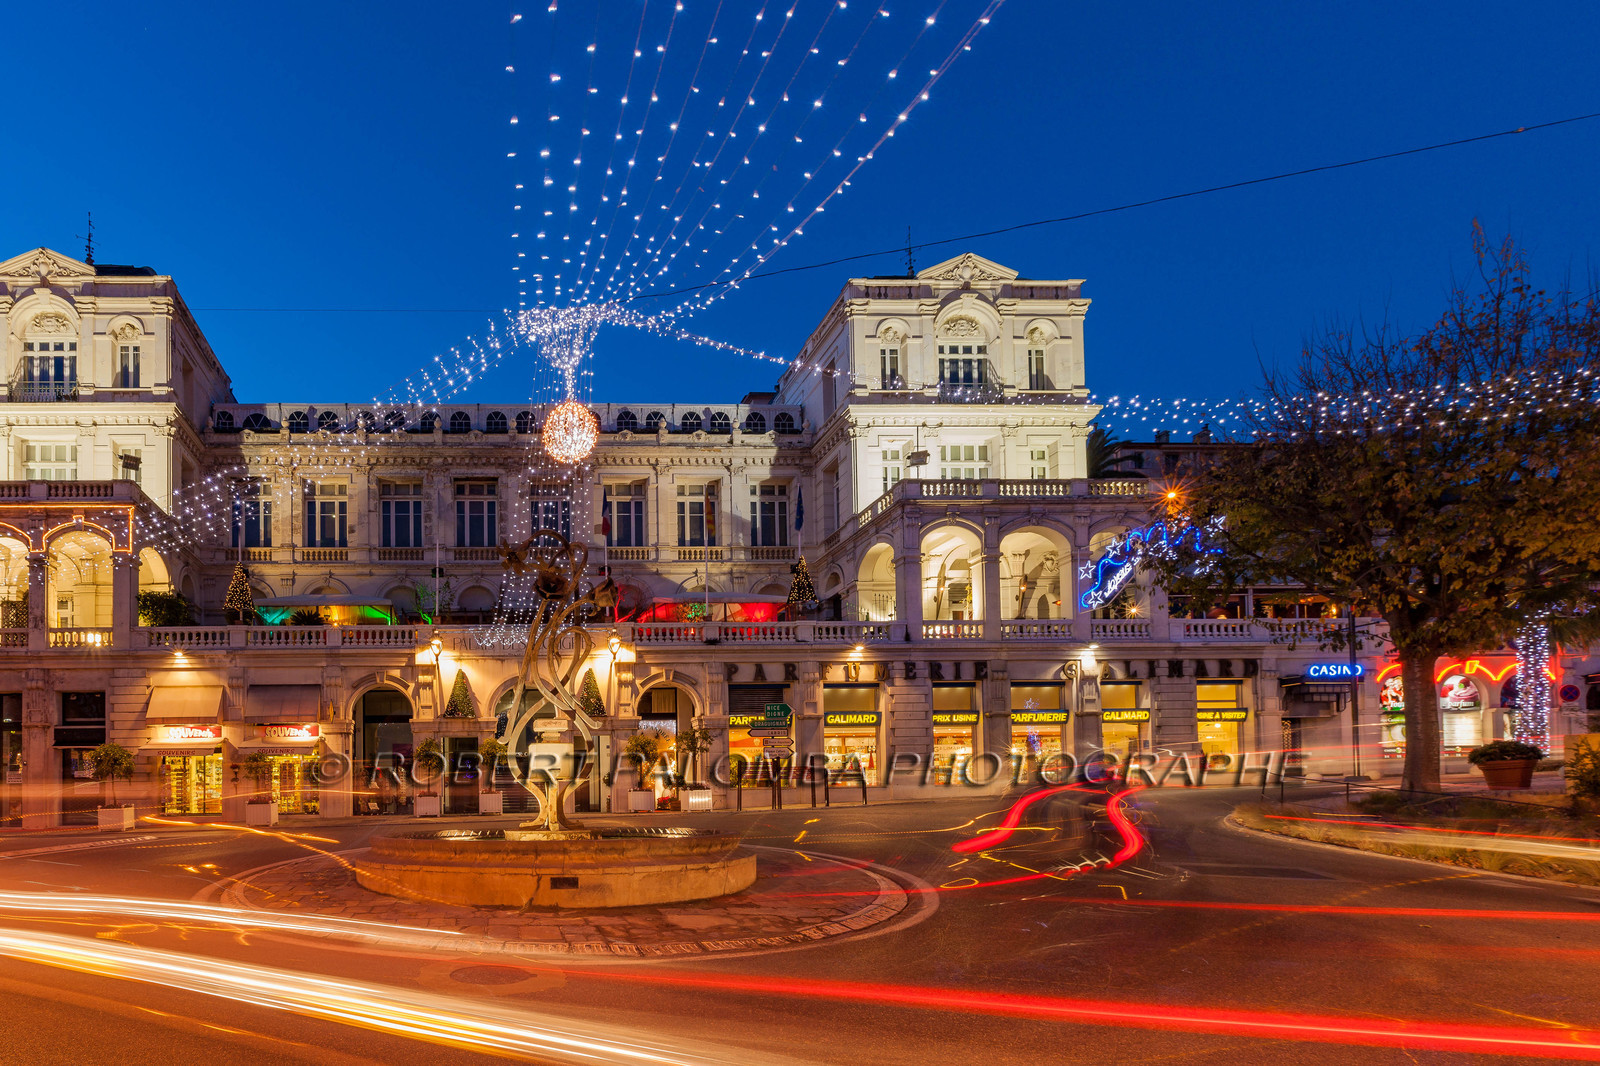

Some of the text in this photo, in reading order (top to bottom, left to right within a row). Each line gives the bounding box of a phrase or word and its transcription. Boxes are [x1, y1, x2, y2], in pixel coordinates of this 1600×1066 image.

[453, 637, 495, 650] PALAIS
[502, 637, 527, 650] DES
[726, 659, 1259, 682] PARFUMERIE GALIMARD
[1310, 665, 1362, 676] CASINO
[827, 714, 877, 724] GALIMARD
[932, 714, 978, 722] PRIX USINE
[1010, 713, 1067, 722] PARFUMERIE
[1103, 711, 1150, 720] GALIMARD
[1221, 711, 1246, 719] VISITER
